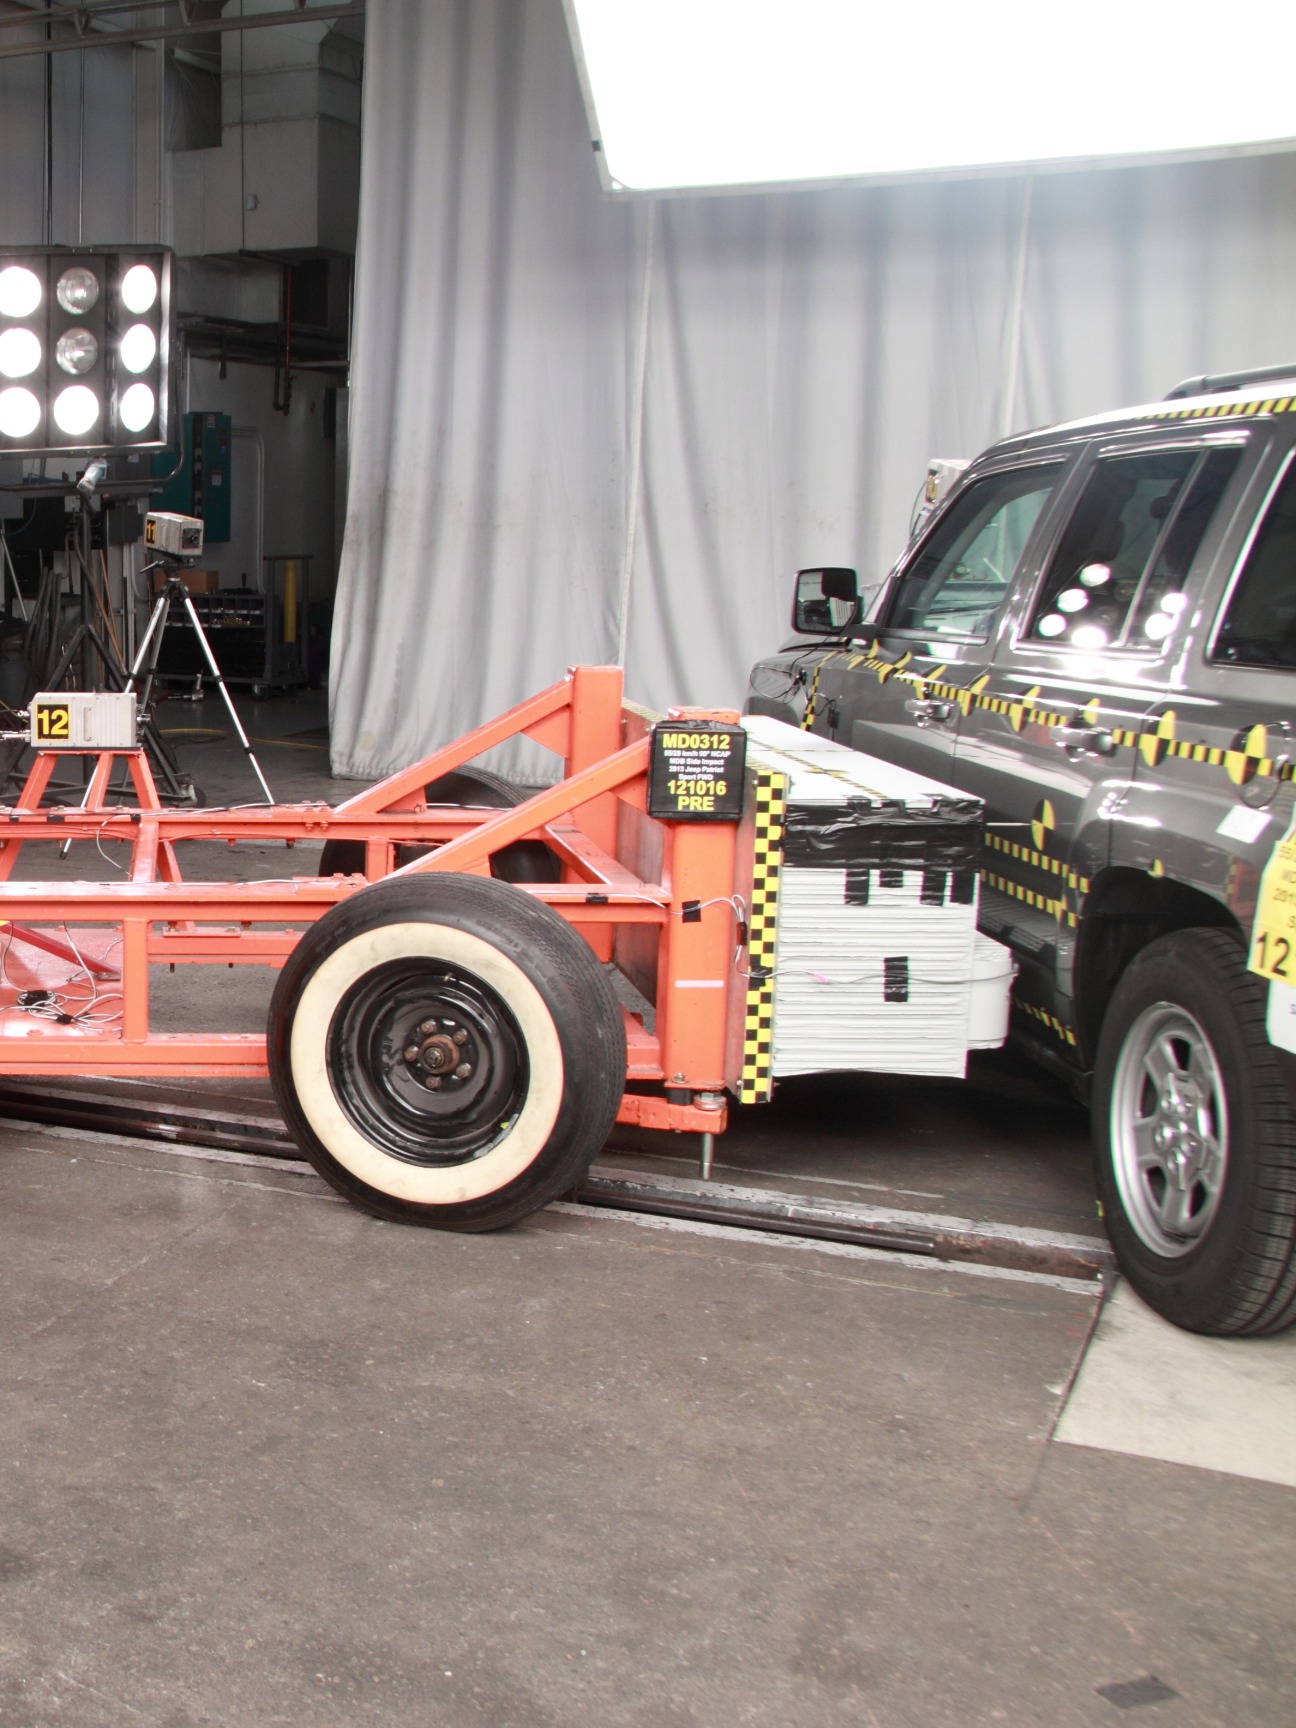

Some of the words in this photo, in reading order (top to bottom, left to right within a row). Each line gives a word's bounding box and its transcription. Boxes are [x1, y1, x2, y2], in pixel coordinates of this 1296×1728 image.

[37, 708, 68, 735] 12
[662, 733, 730, 749] MD0312
[685, 766, 701, 774] Jeep
[668, 780, 727, 796] 121016
[678, 796, 715, 811] PRE
[1256, 931, 1296, 977] 12
